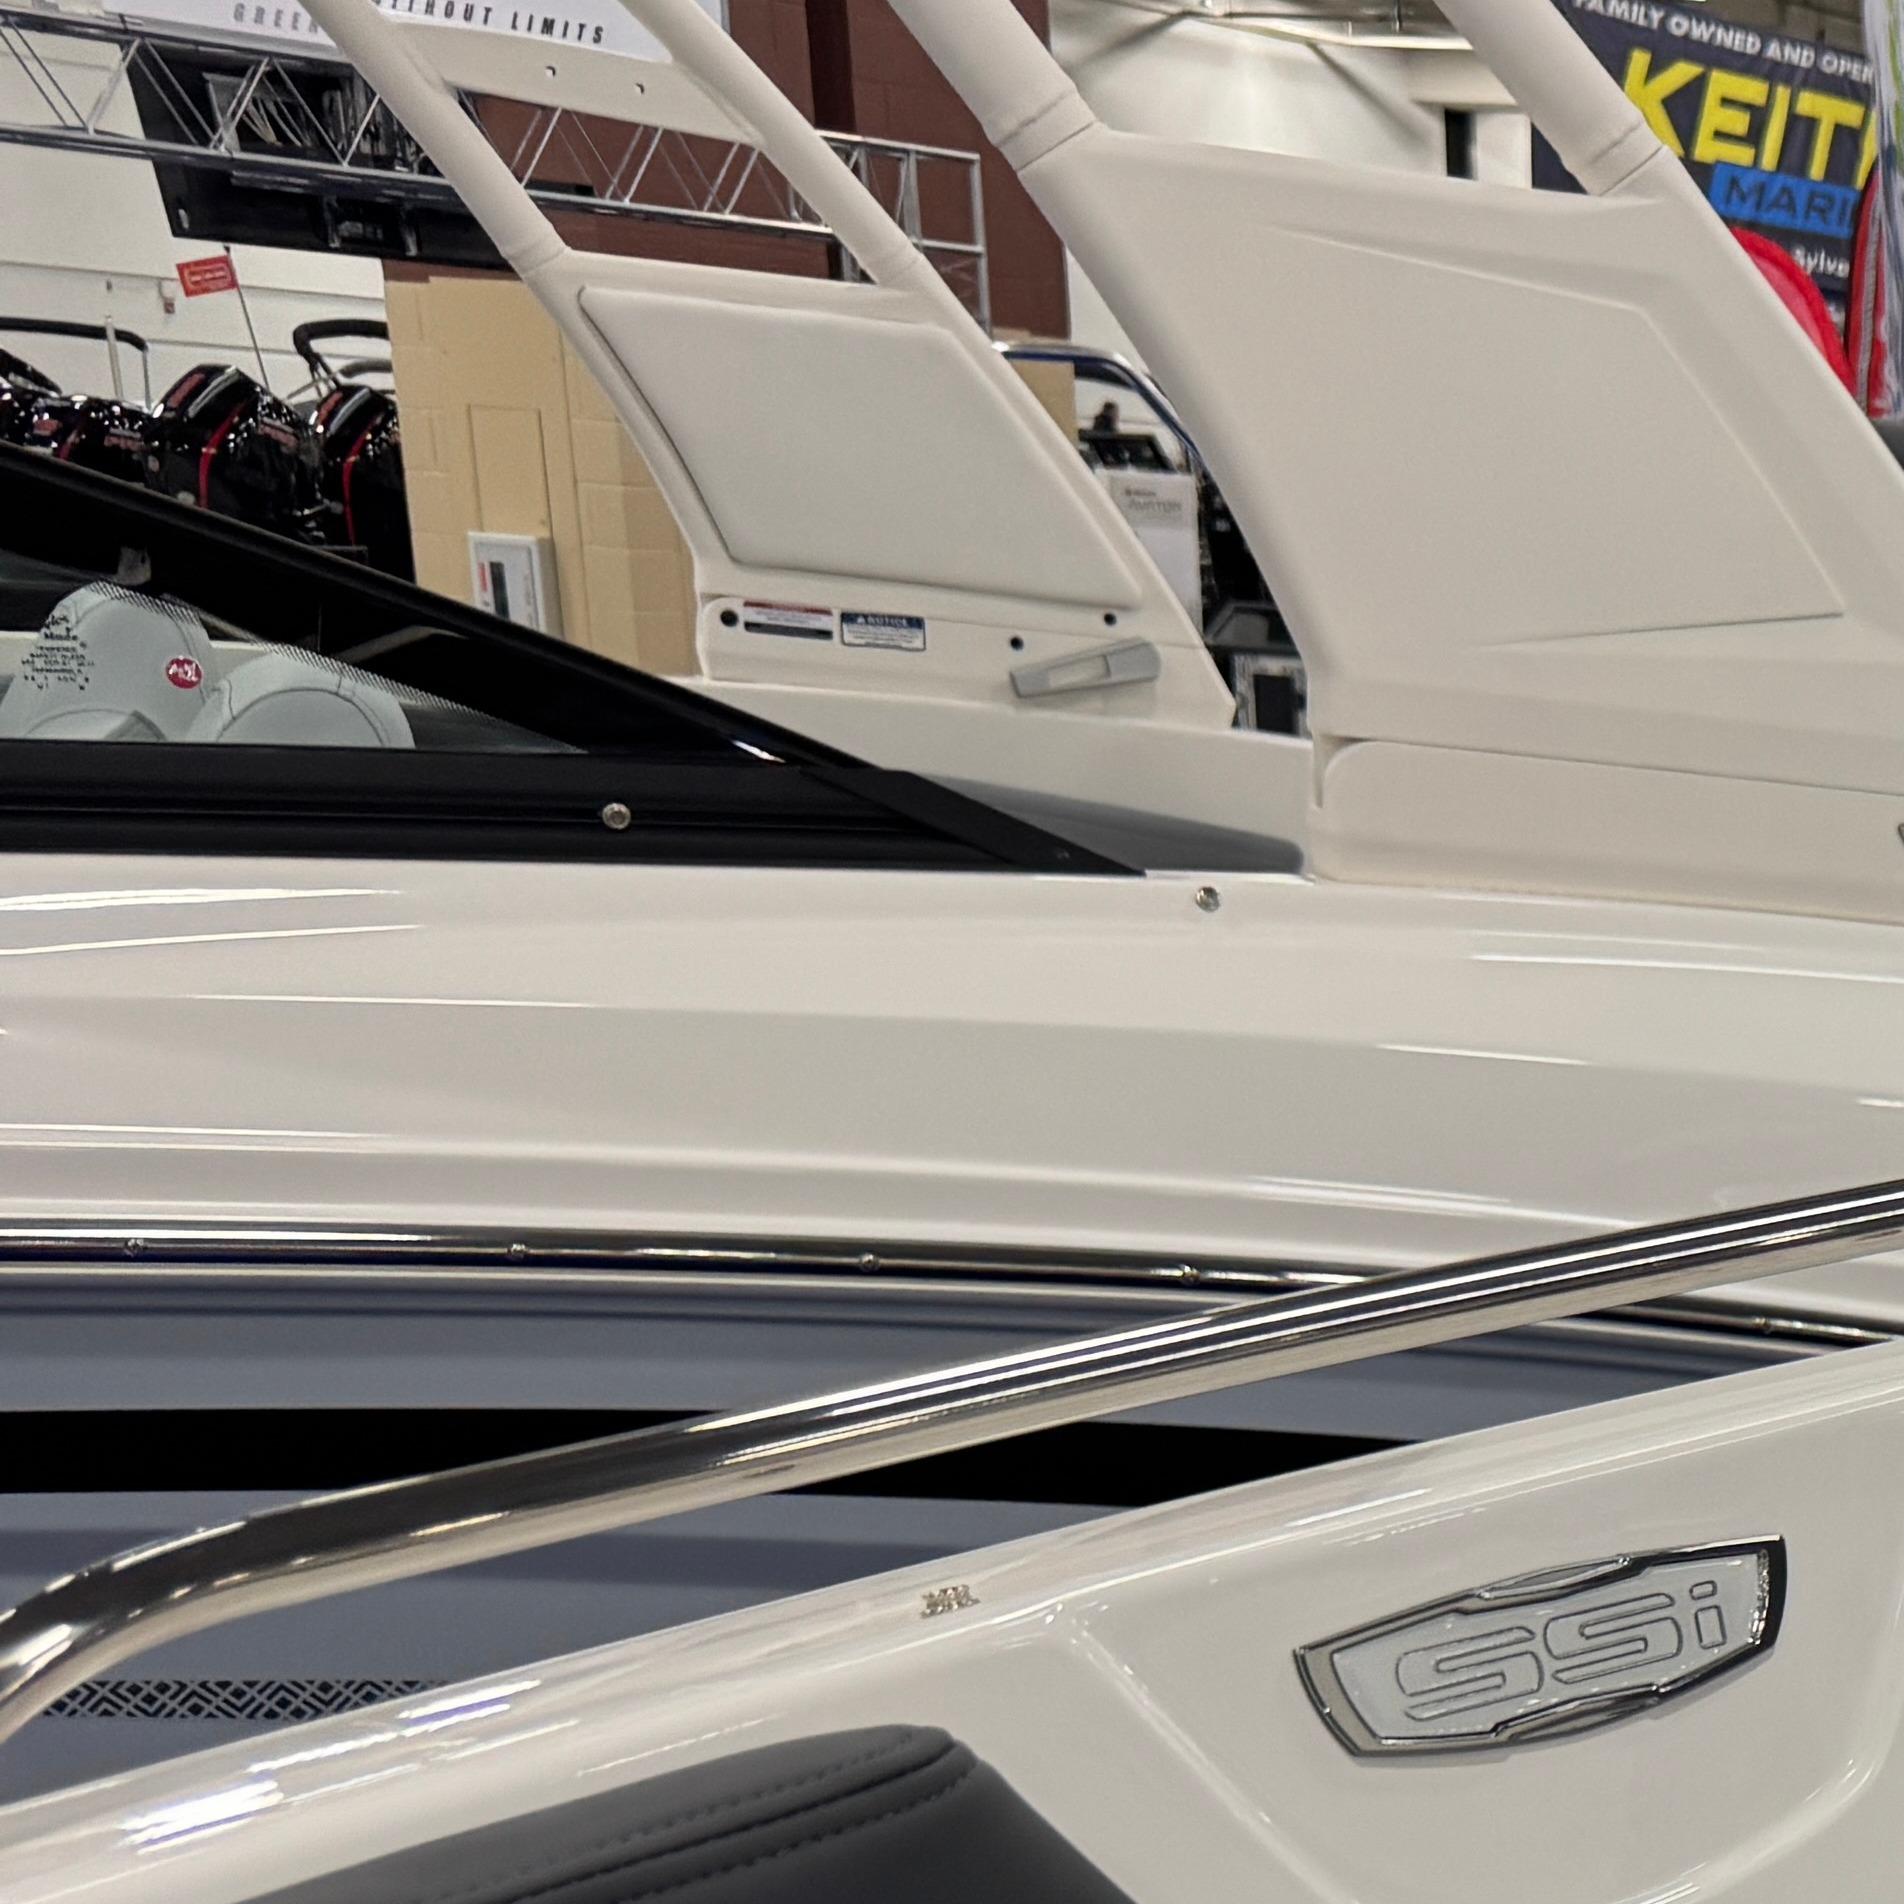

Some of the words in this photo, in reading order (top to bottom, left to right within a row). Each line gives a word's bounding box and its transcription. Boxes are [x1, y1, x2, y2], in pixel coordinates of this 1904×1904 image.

[510, 11, 604, 44] LIMITS
[1666, 14, 1761, 55] OWNED
[1763, 41, 1815, 68] AND
[1793, 245, 1850, 279] Sylva
